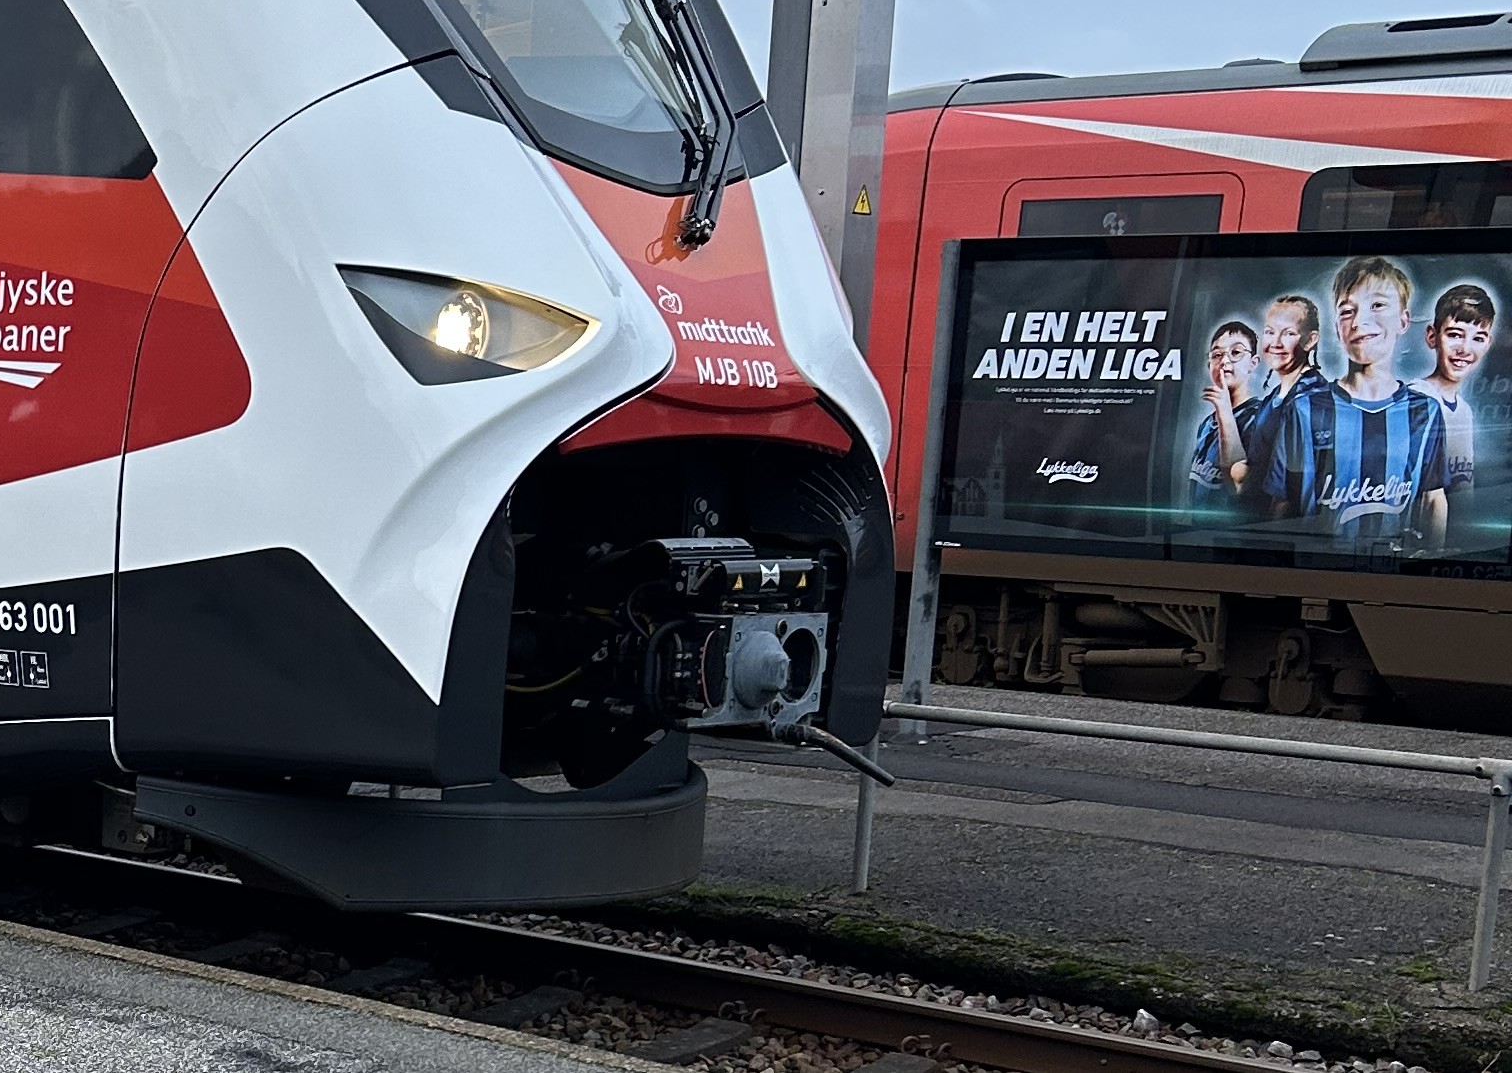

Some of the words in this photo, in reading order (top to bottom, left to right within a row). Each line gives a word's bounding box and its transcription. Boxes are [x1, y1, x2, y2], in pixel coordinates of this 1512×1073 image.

[1000, 312, 1017, 342] I
[1020, 312, 1070, 342] EN
[1073, 311, 1168, 342] HELT
[694, 356, 740, 386] MJB
[743, 359, 778, 389] 10B
[972, 349, 1097, 379] ANDEN
[1099, 348, 1182, 380] LIGA
[1035, 457, 1099, 479] Lykkeliga
[1317, 474, 1412, 510] Lykkeliga
[33, 602, 76, 635] 001
